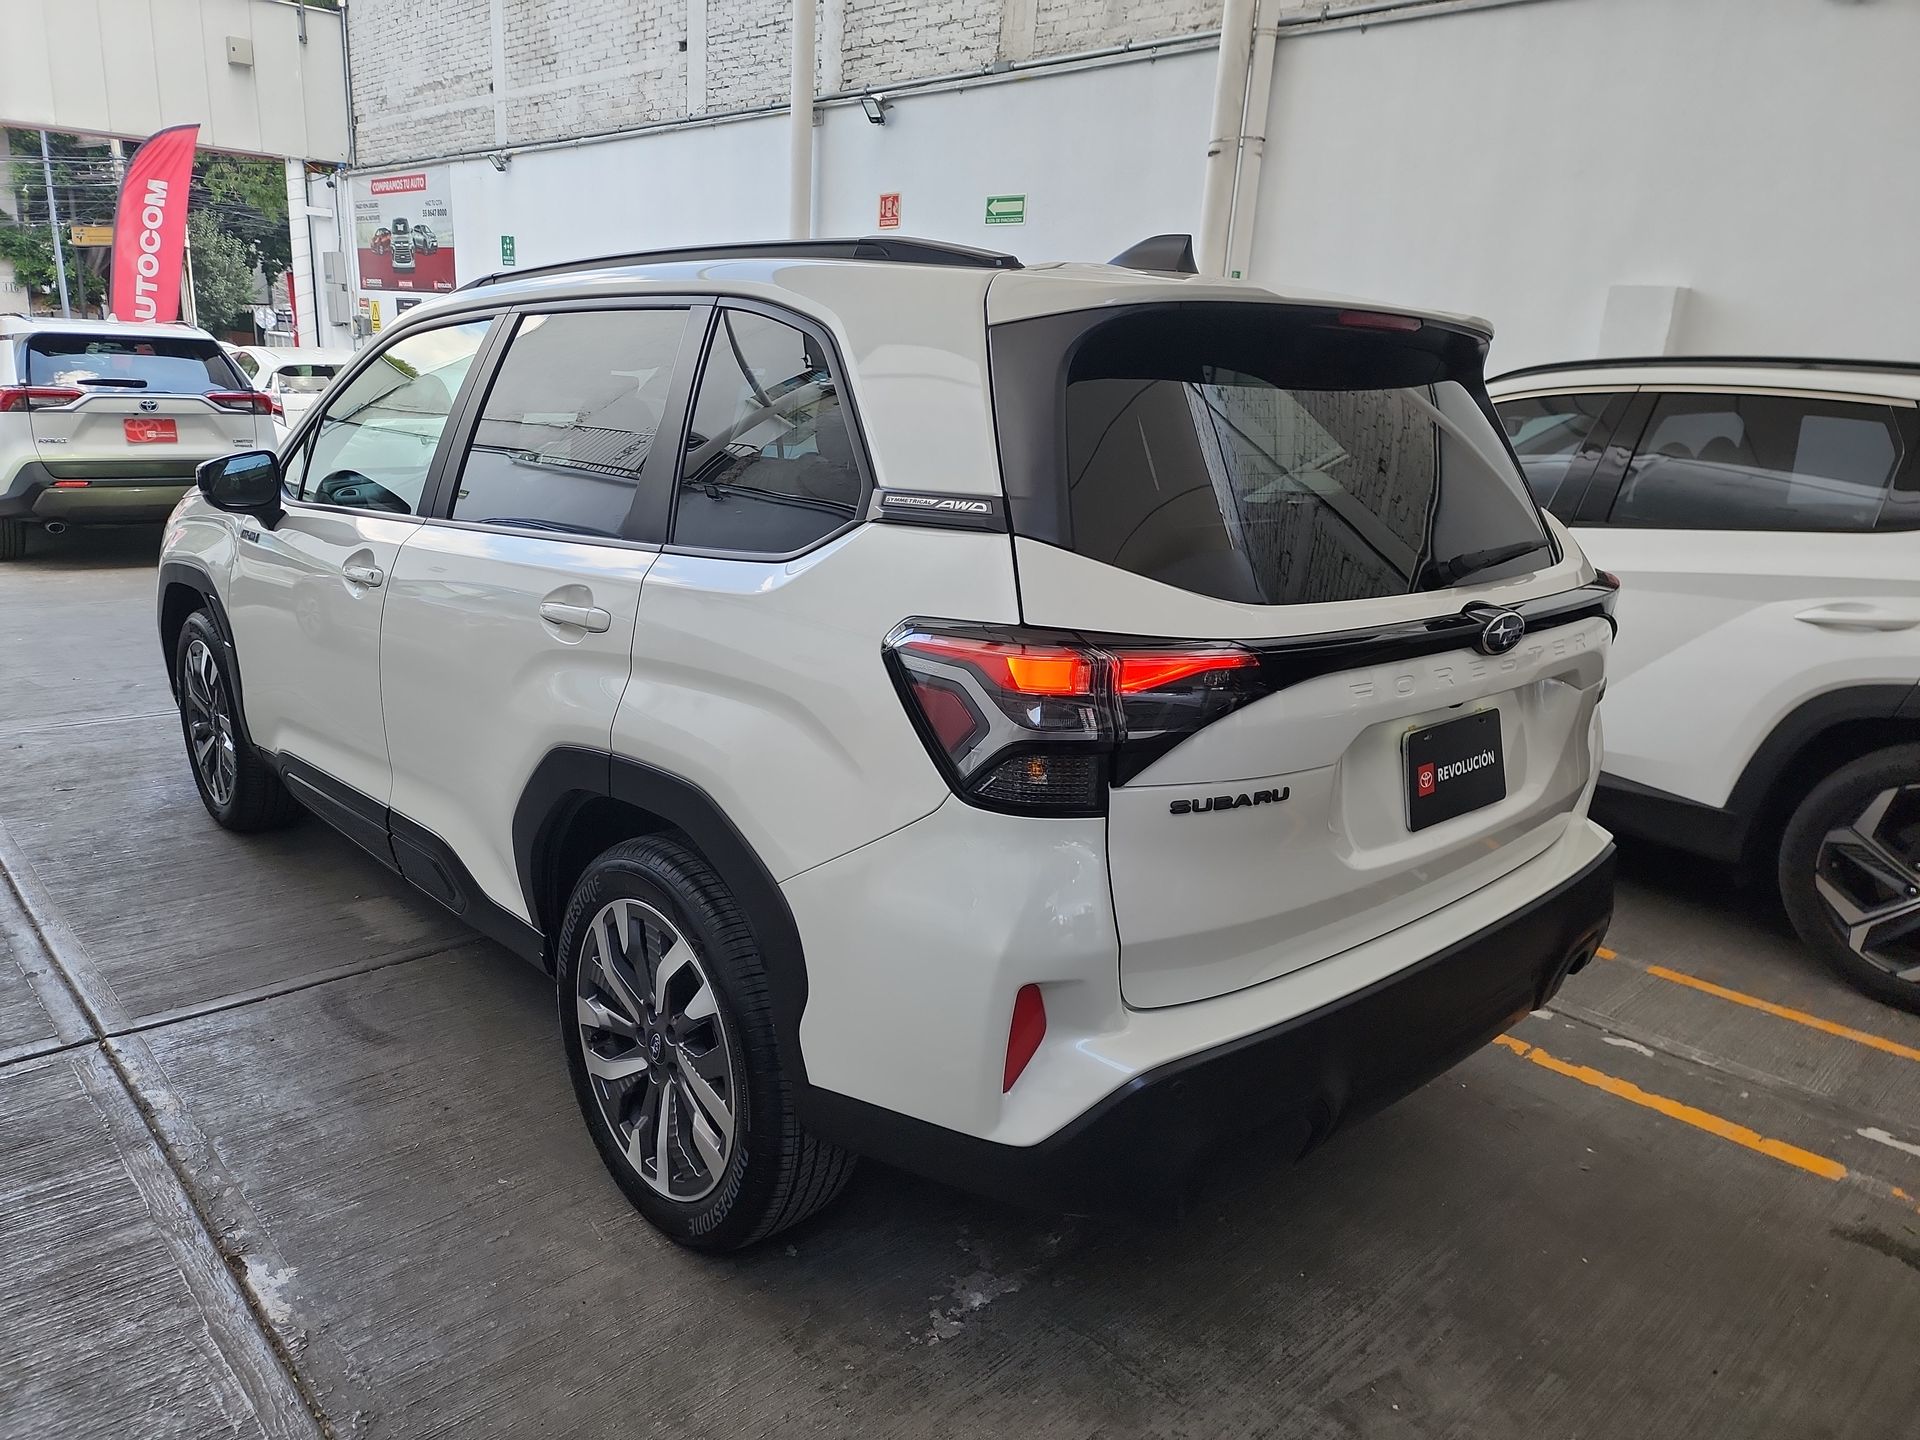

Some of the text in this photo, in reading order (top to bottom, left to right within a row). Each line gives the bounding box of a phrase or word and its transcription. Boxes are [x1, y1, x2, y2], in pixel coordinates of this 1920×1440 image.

[372, 177, 424, 192] COMPRAMOS TU AUTO
[886, 496, 987, 513] SYMMETRICAL AWD
[1349, 632, 1586, 698] FORESTER
[1437, 750, 1495, 783] REVOLUCIÓN
[1169, 786, 1290, 814] SUBARU
[558, 875, 600, 977] BRIDGESTONE
[689, 1147, 749, 1236] BRIDGESTONE
